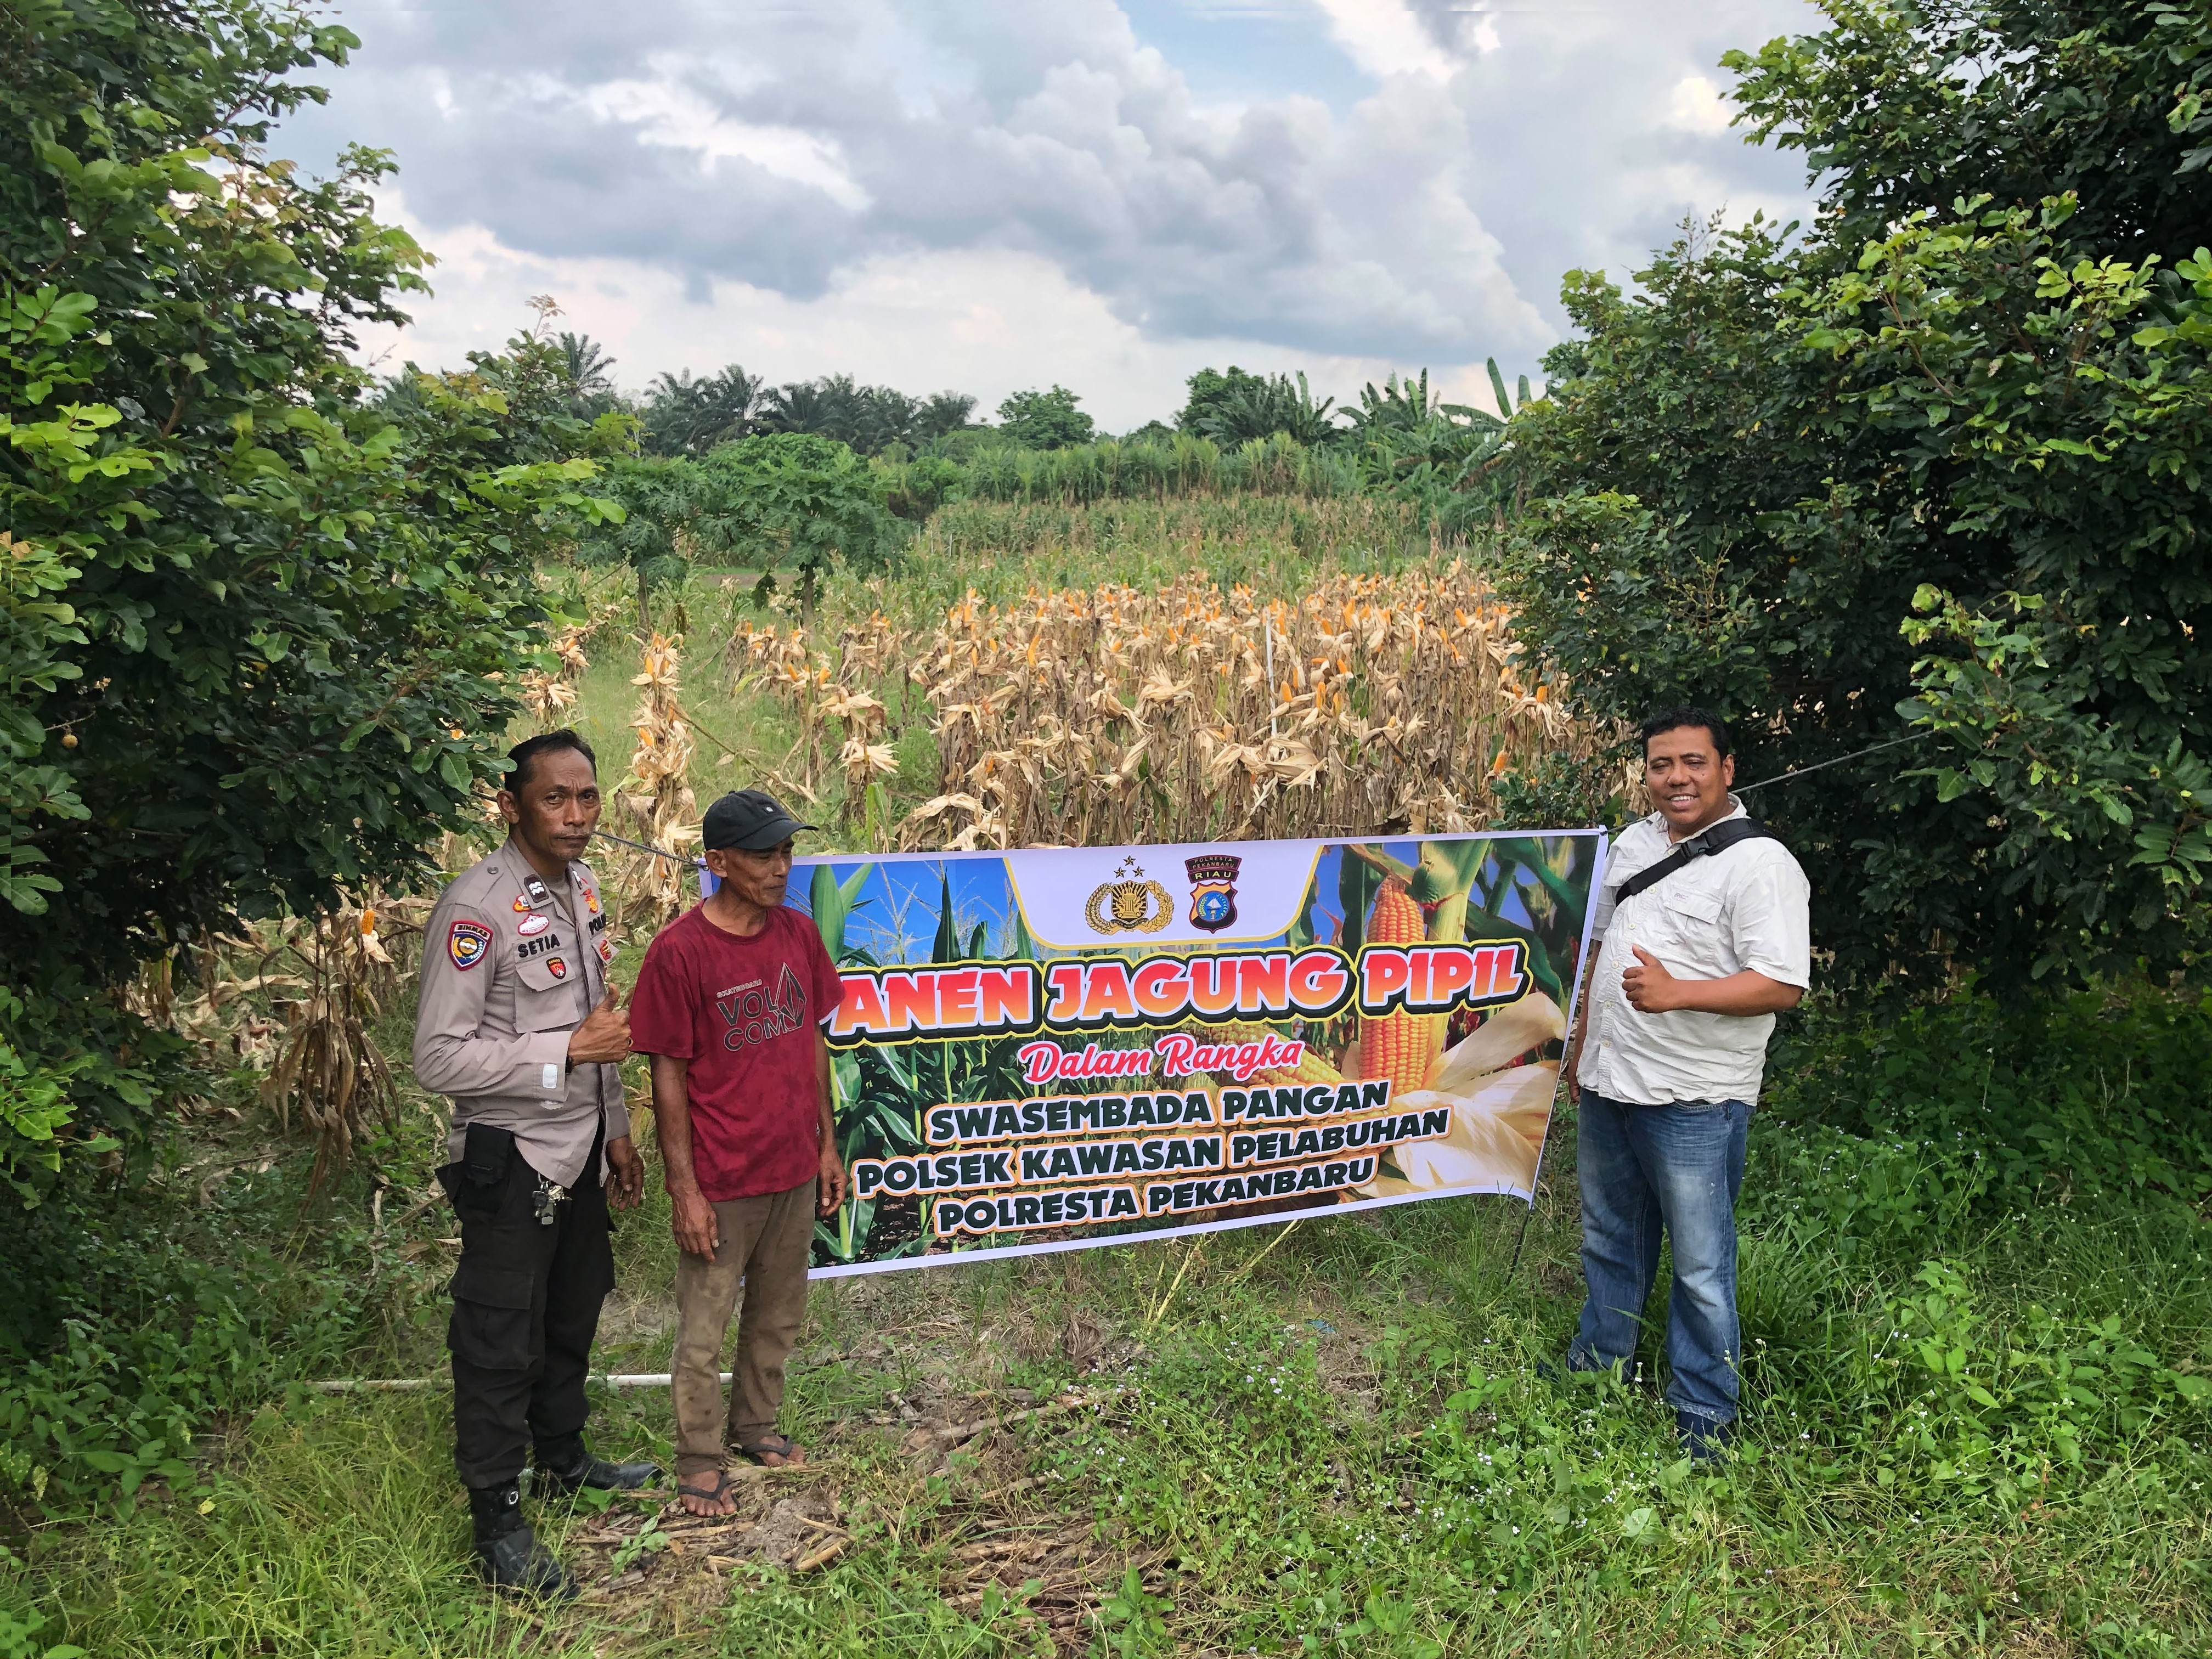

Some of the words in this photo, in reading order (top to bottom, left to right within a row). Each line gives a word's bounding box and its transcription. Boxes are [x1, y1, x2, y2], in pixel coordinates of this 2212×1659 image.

[1195, 871, 1232, 879] RIAU
[458, 924, 488, 938] BINMAS
[588, 912, 606, 935] POL
[517, 934, 560, 958] SETIA
[716, 979, 763, 998] SKATEBOARD
[716, 986, 778, 1026] VOL
[824, 966, 1034, 1036] ANEN
[1048, 952, 1348, 1021] JAGUNG
[1362, 945, 1523, 1007] PIPIL
[723, 1013, 788, 1052] COM
[1019, 1040, 1151, 1085] Dalam
[1155, 1032, 1306, 1081] Rangka
[930, 1092, 1214, 1141] SWASEMBADA
[1222, 1081, 1390, 1121] PANGAN
[856, 1152, 1011, 1195] POLSEK
[1020, 1137, 1221, 1180] KAWASAN
[1231, 1108, 1452, 1164] PELABUHAN
[937, 1187, 1139, 1233] POLRESTA
[1148, 1156, 1375, 1214] PEKANBARU
